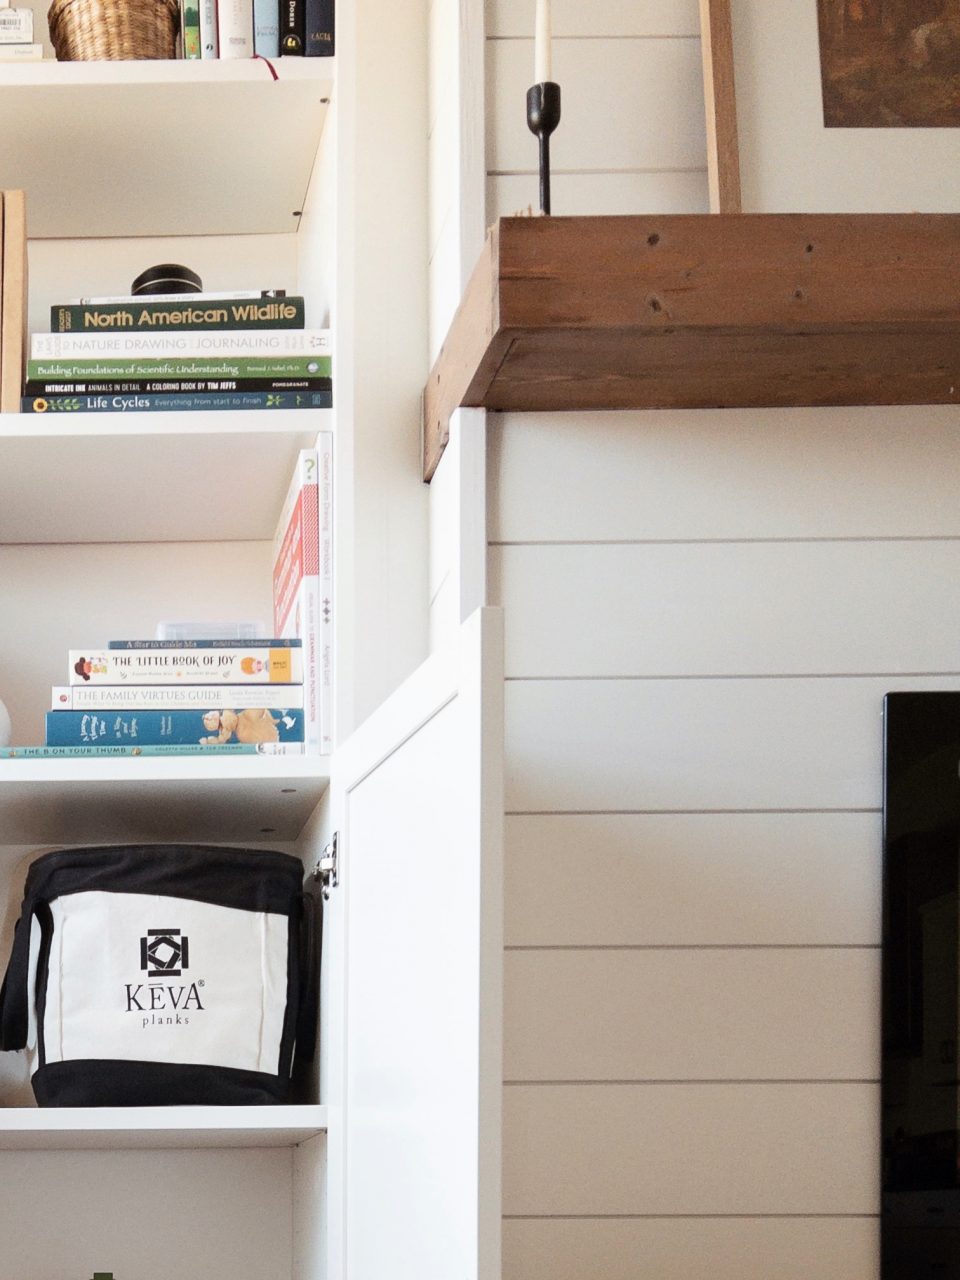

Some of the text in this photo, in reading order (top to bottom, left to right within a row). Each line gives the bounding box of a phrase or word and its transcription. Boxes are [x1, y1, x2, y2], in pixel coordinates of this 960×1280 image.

[84, 302, 297, 328] North American Wildlife
[73, 340, 120, 351] NATURE
[124, 339, 186, 350] DRAWING
[196, 337, 280, 349] JOURNALING
[38, 362, 239, 377] Building Foundations of Scientific Understanding
[45, 384, 74, 393] INTRICATE
[75, 384, 86, 392] INK
[88, 384, 113, 392] ANIMALS
[122, 383, 140, 391] DETAIL
[146, 383, 151, 391] A
[152, 382, 180, 391] COLORING
[181, 382, 196, 390] BOOK
[197, 382, 205, 390] BY
[207, 381, 219, 390] TIM
[220, 381, 237, 390] JEFFS
[87, 397, 108, 409] Life
[112, 396, 150, 411] Cycles
[154, 398, 193, 407] Everything
[194, 397, 211, 406] from
[134, 641, 148, 649] Star
[113, 655, 237, 668] THE LITTLE BOOK OF JOY
[77, 690, 98, 701] THE
[100, 690, 138, 701] FAMILY
[141, 690, 186, 701] VIRTUES
[188, 690, 222, 701] GUIDE
[142, 1014, 189, 1028] planks
